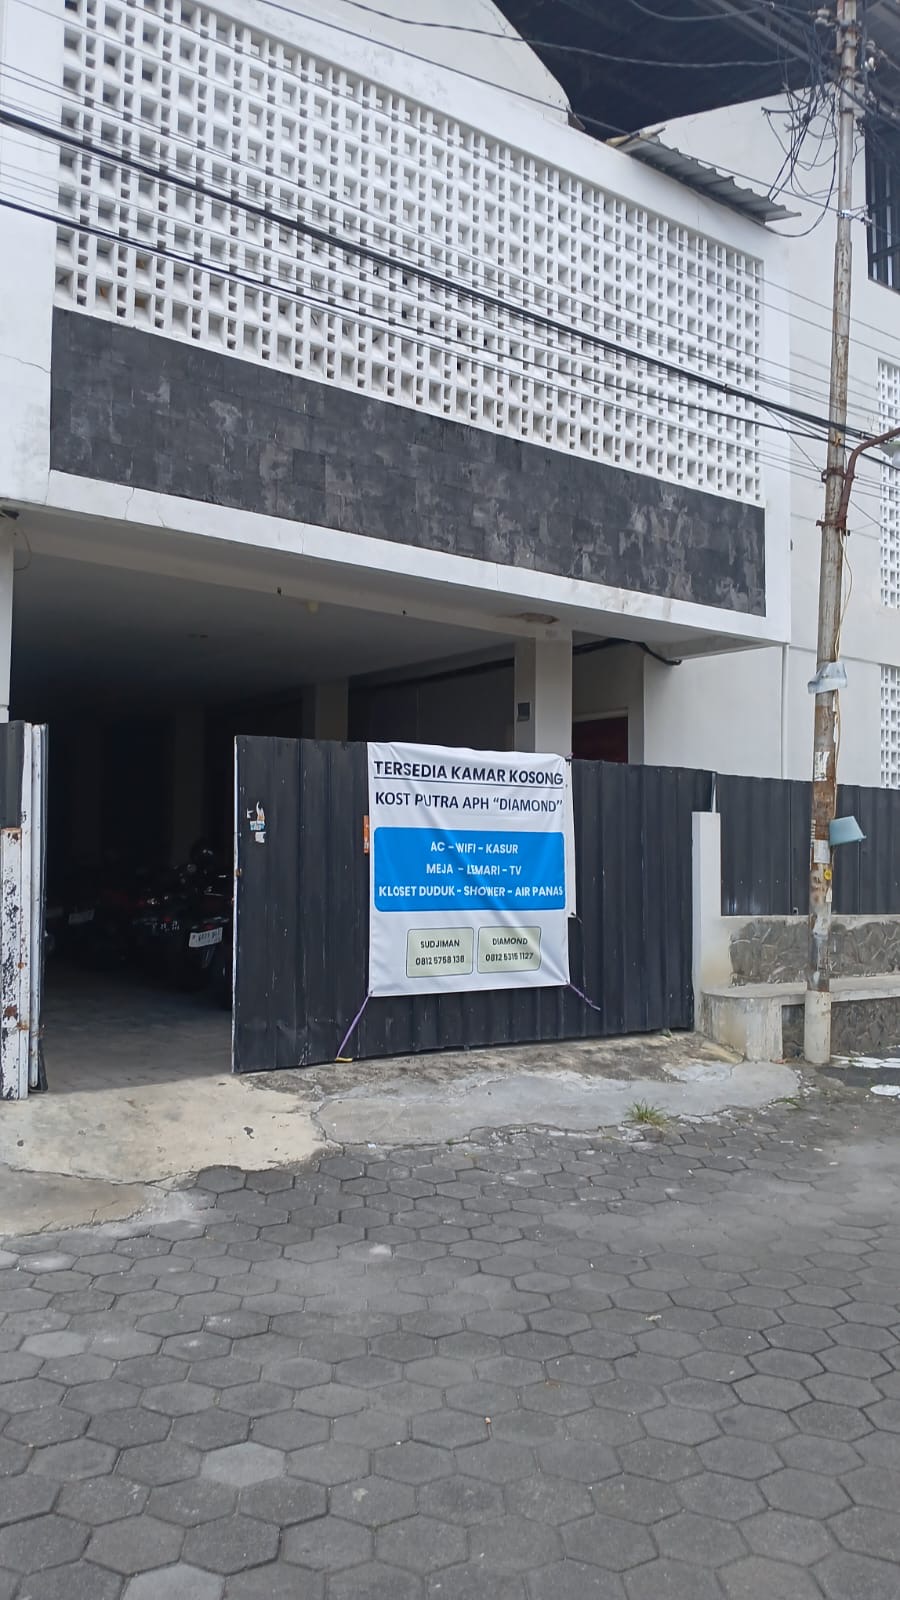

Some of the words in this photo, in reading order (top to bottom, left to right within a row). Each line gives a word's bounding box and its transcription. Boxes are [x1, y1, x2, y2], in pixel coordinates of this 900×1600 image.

[374, 761, 447, 779] TERSEDIA
[452, 766, 505, 783] KAMAR
[509, 770, 563, 785] KOSONG
[375, 792, 410, 806] KOST
[415, 794, 459, 809] PUTRA
[462, 796, 489, 809] APH
[431, 842, 445, 852] AC
[456, 843, 476, 853] WIFI
[485, 844, 518, 854] KASUR
[426, 864, 453, 874] MEJA
[509, 866, 521, 875] TV
[379, 886, 417, 897] KLOSET
[419, 886, 455, 896] DUDUK
[464, 886, 505, 896] SHOWER
[515, 887, 530, 897] AIR
[533, 886, 563, 896] PANAS
[420, 939, 460, 948] SUDJIMAN
[492, 937, 528, 946] DIAMOND
[416, 957, 432, 965] 0812
[485, 953, 502, 962] 0812
